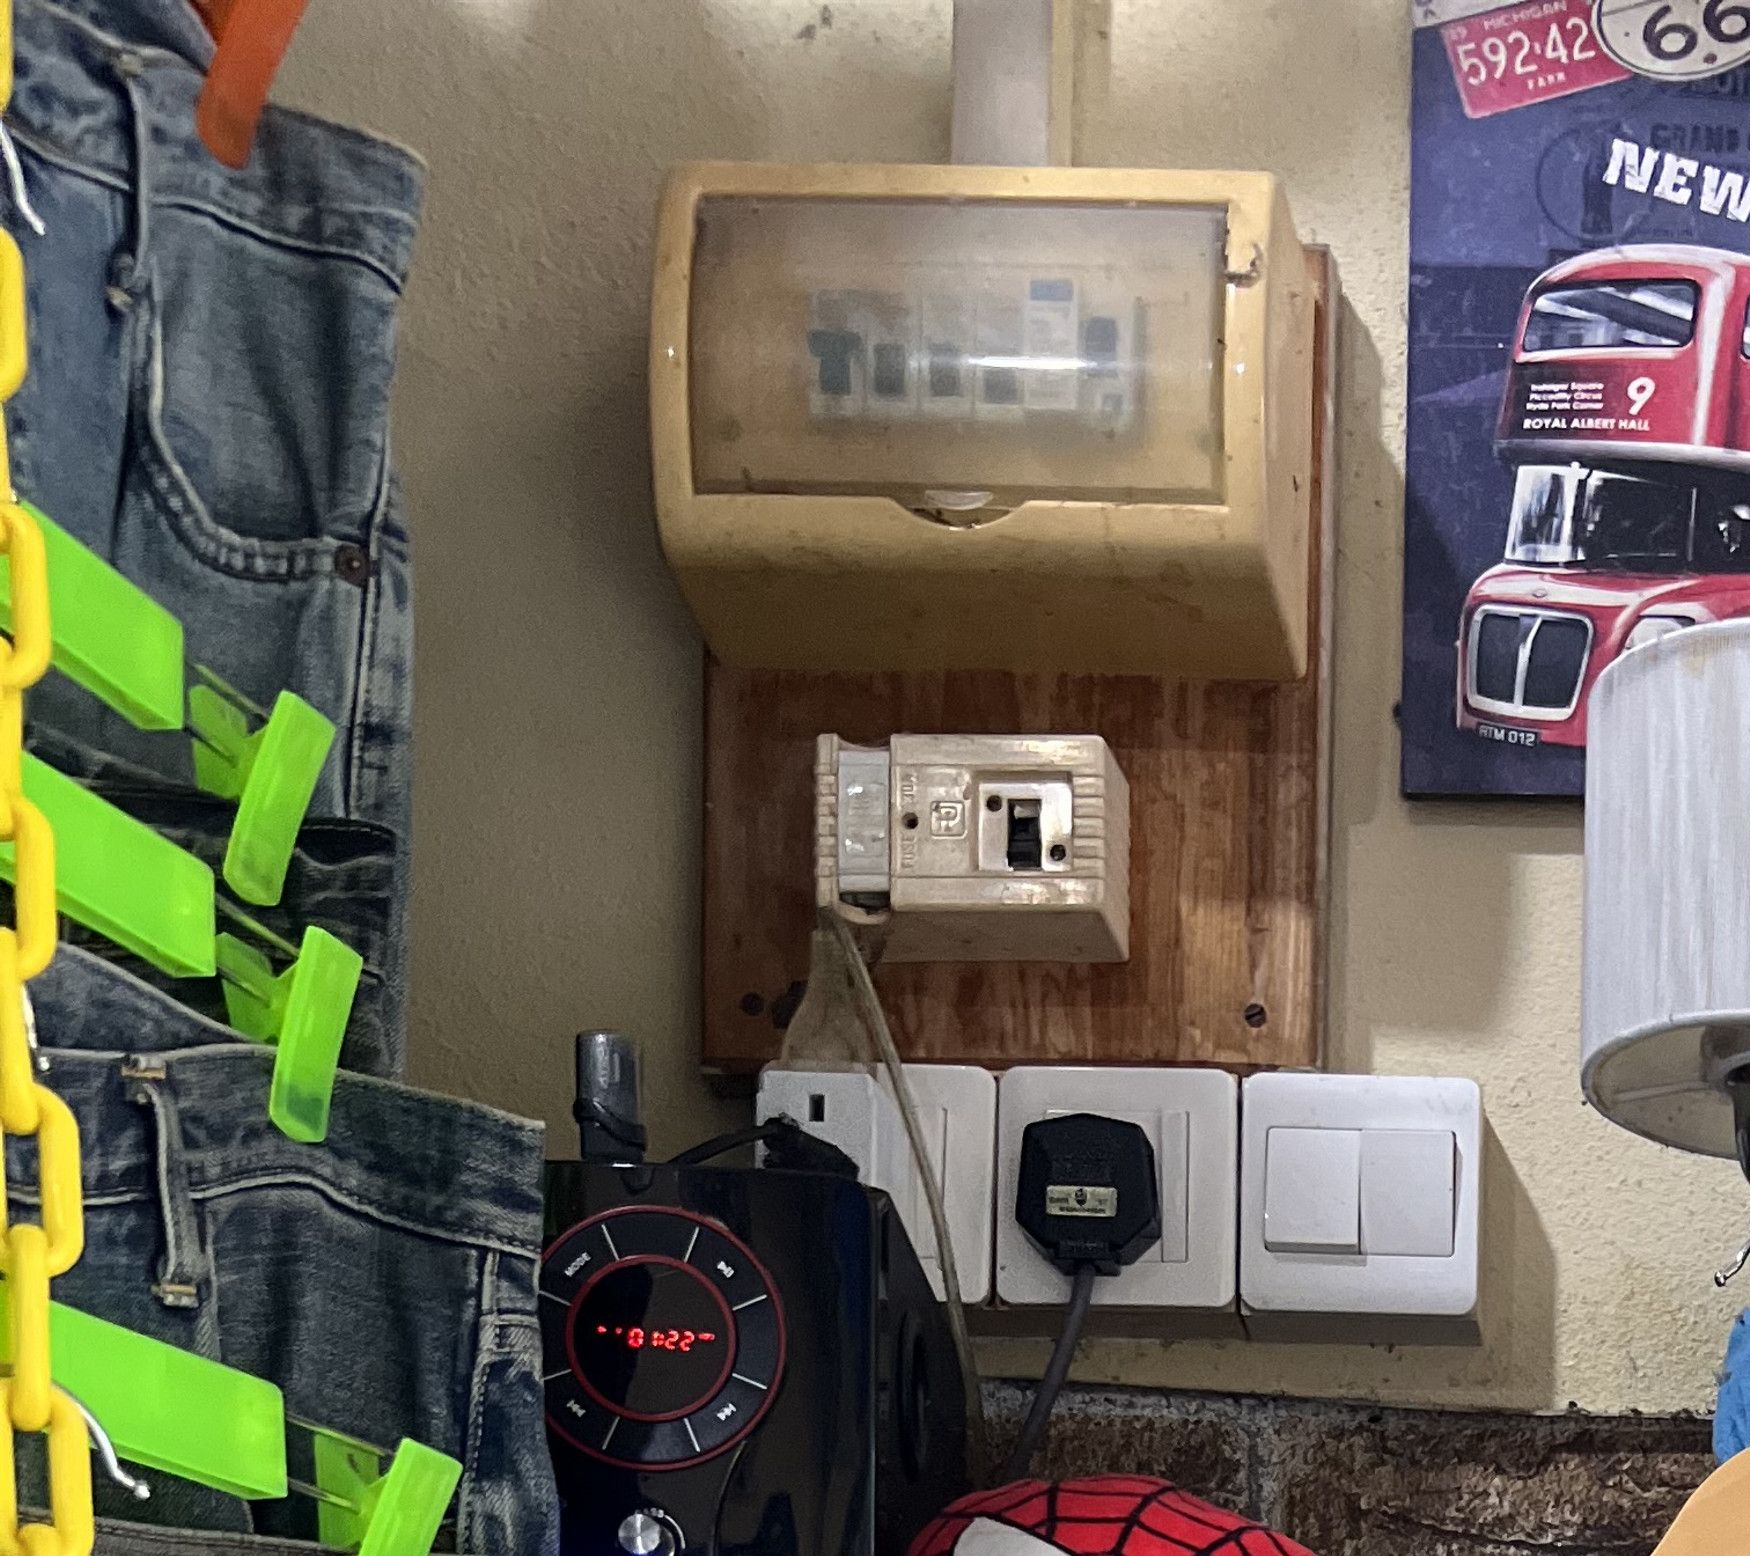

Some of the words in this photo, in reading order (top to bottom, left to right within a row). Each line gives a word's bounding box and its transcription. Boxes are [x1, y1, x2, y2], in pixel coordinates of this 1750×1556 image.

[1627, 376, 1656, 416] 9
[1523, 418, 1567, 430] ROYAL
[1570, 418, 1616, 430] ALBERT
[1618, 419, 1650, 431] HALL
[1508, 730, 1537, 747] 012
